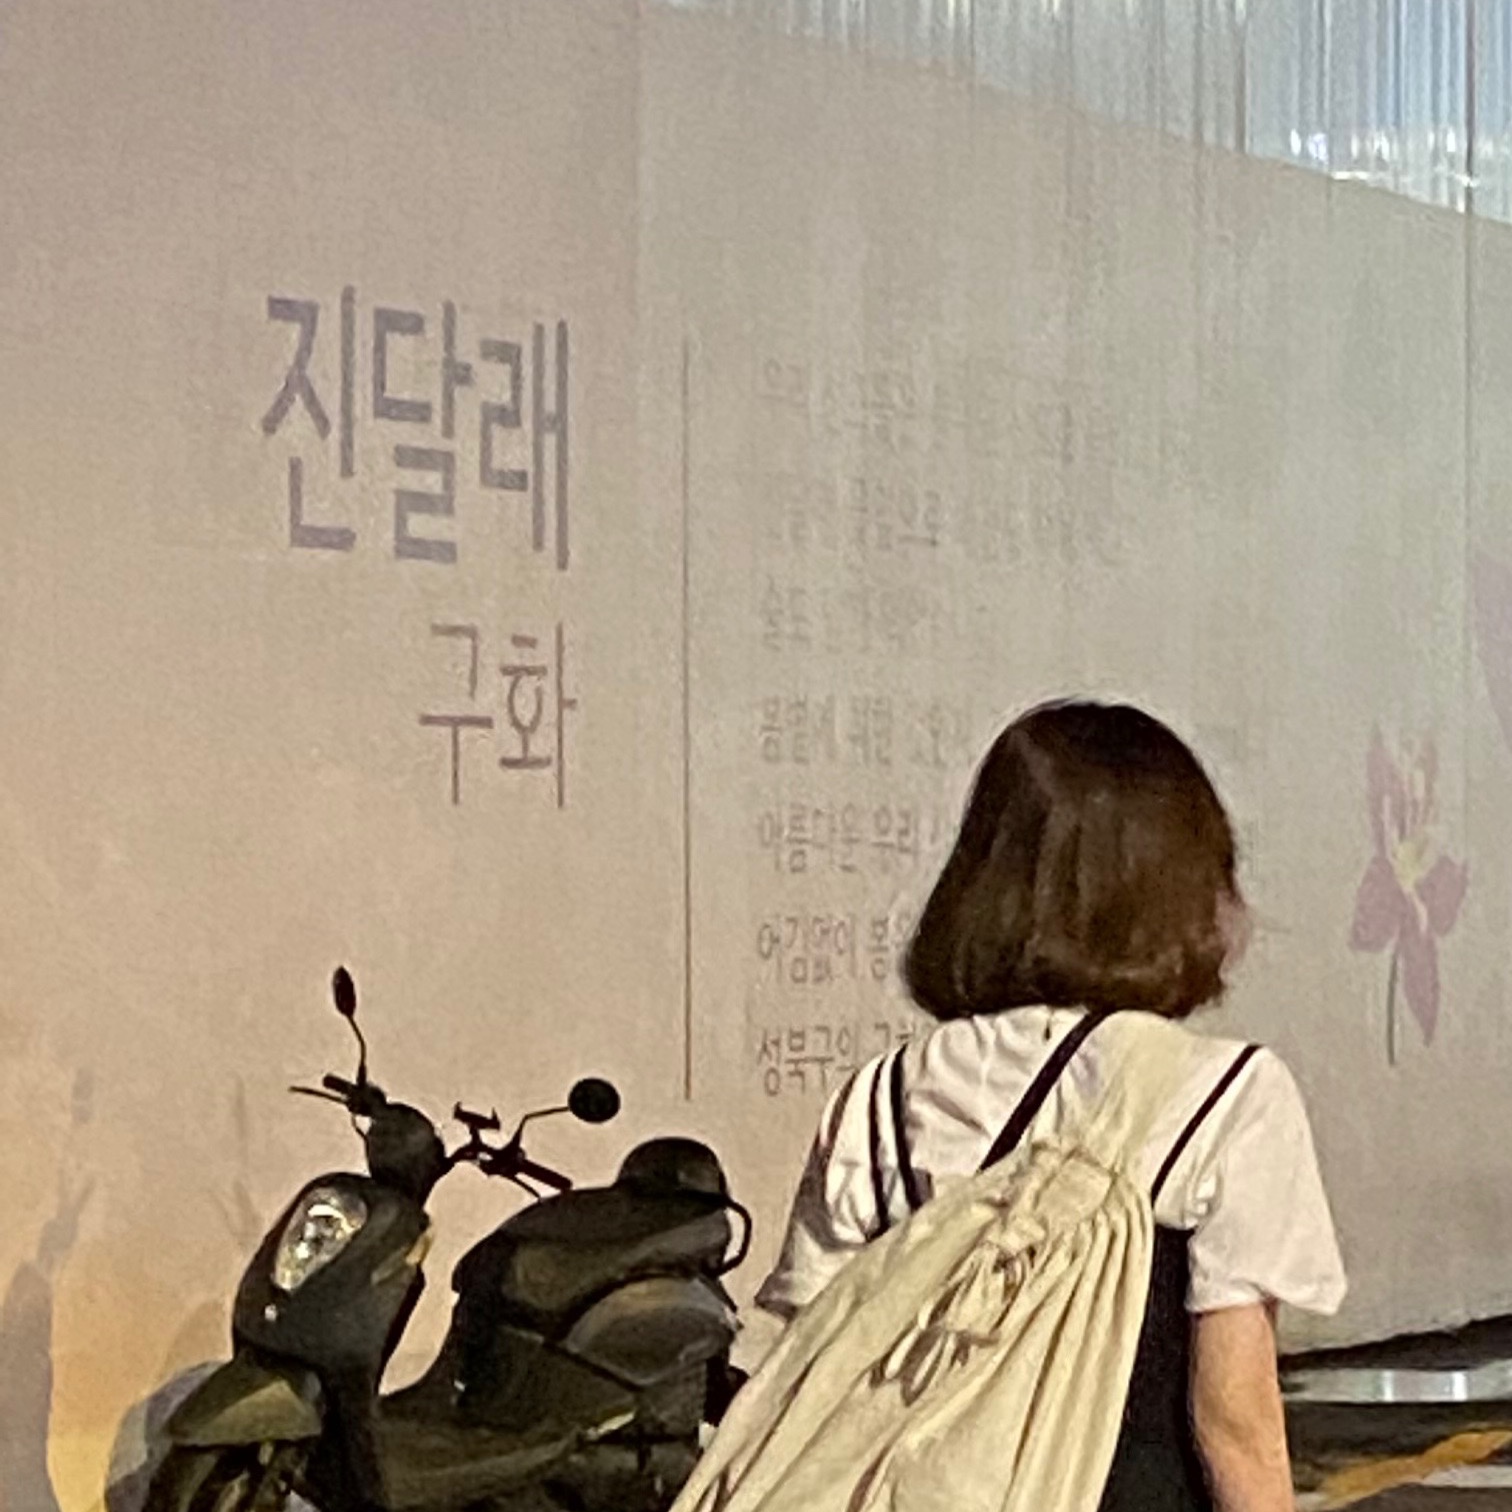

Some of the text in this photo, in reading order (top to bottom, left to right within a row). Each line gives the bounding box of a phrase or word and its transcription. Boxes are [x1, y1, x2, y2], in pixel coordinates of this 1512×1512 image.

[261, 284, 570, 572] 진달래
[418, 620, 578, 810] 구화
[757, 802, 861, 874] 아름다운
[756, 912, 857, 985] 어김없이
[756, 1021, 861, 1098] 성북구의
